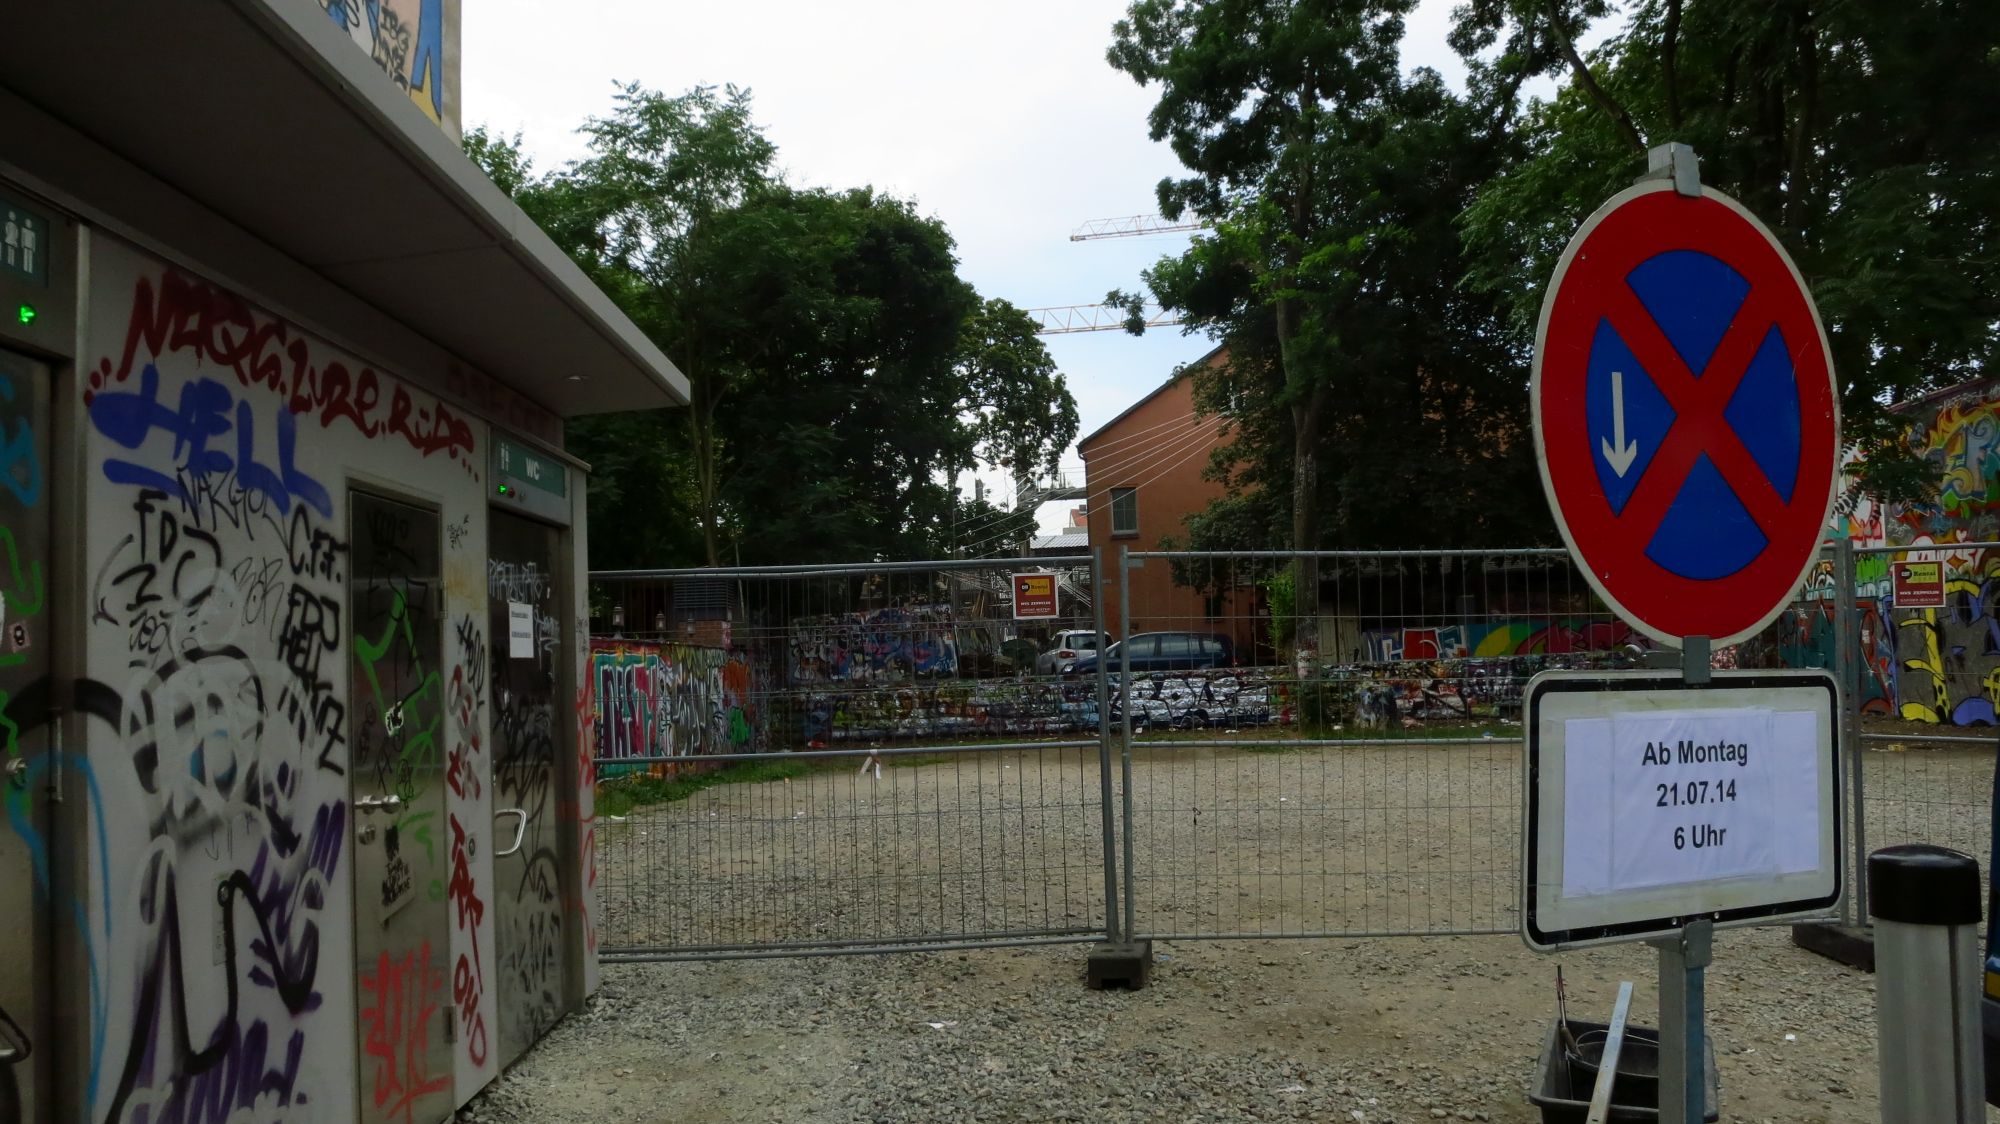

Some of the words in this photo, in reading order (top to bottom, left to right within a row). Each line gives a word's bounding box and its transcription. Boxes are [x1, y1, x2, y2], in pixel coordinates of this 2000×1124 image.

[526, 457, 540, 481] WC
[1642, 741, 1671, 766] Ab
[1678, 740, 1748, 767] Montag
[1656, 779, 1737, 807] 21.07.14
[1674, 826, 1685, 850] 6
[1692, 824, 1727, 849] Uhr
